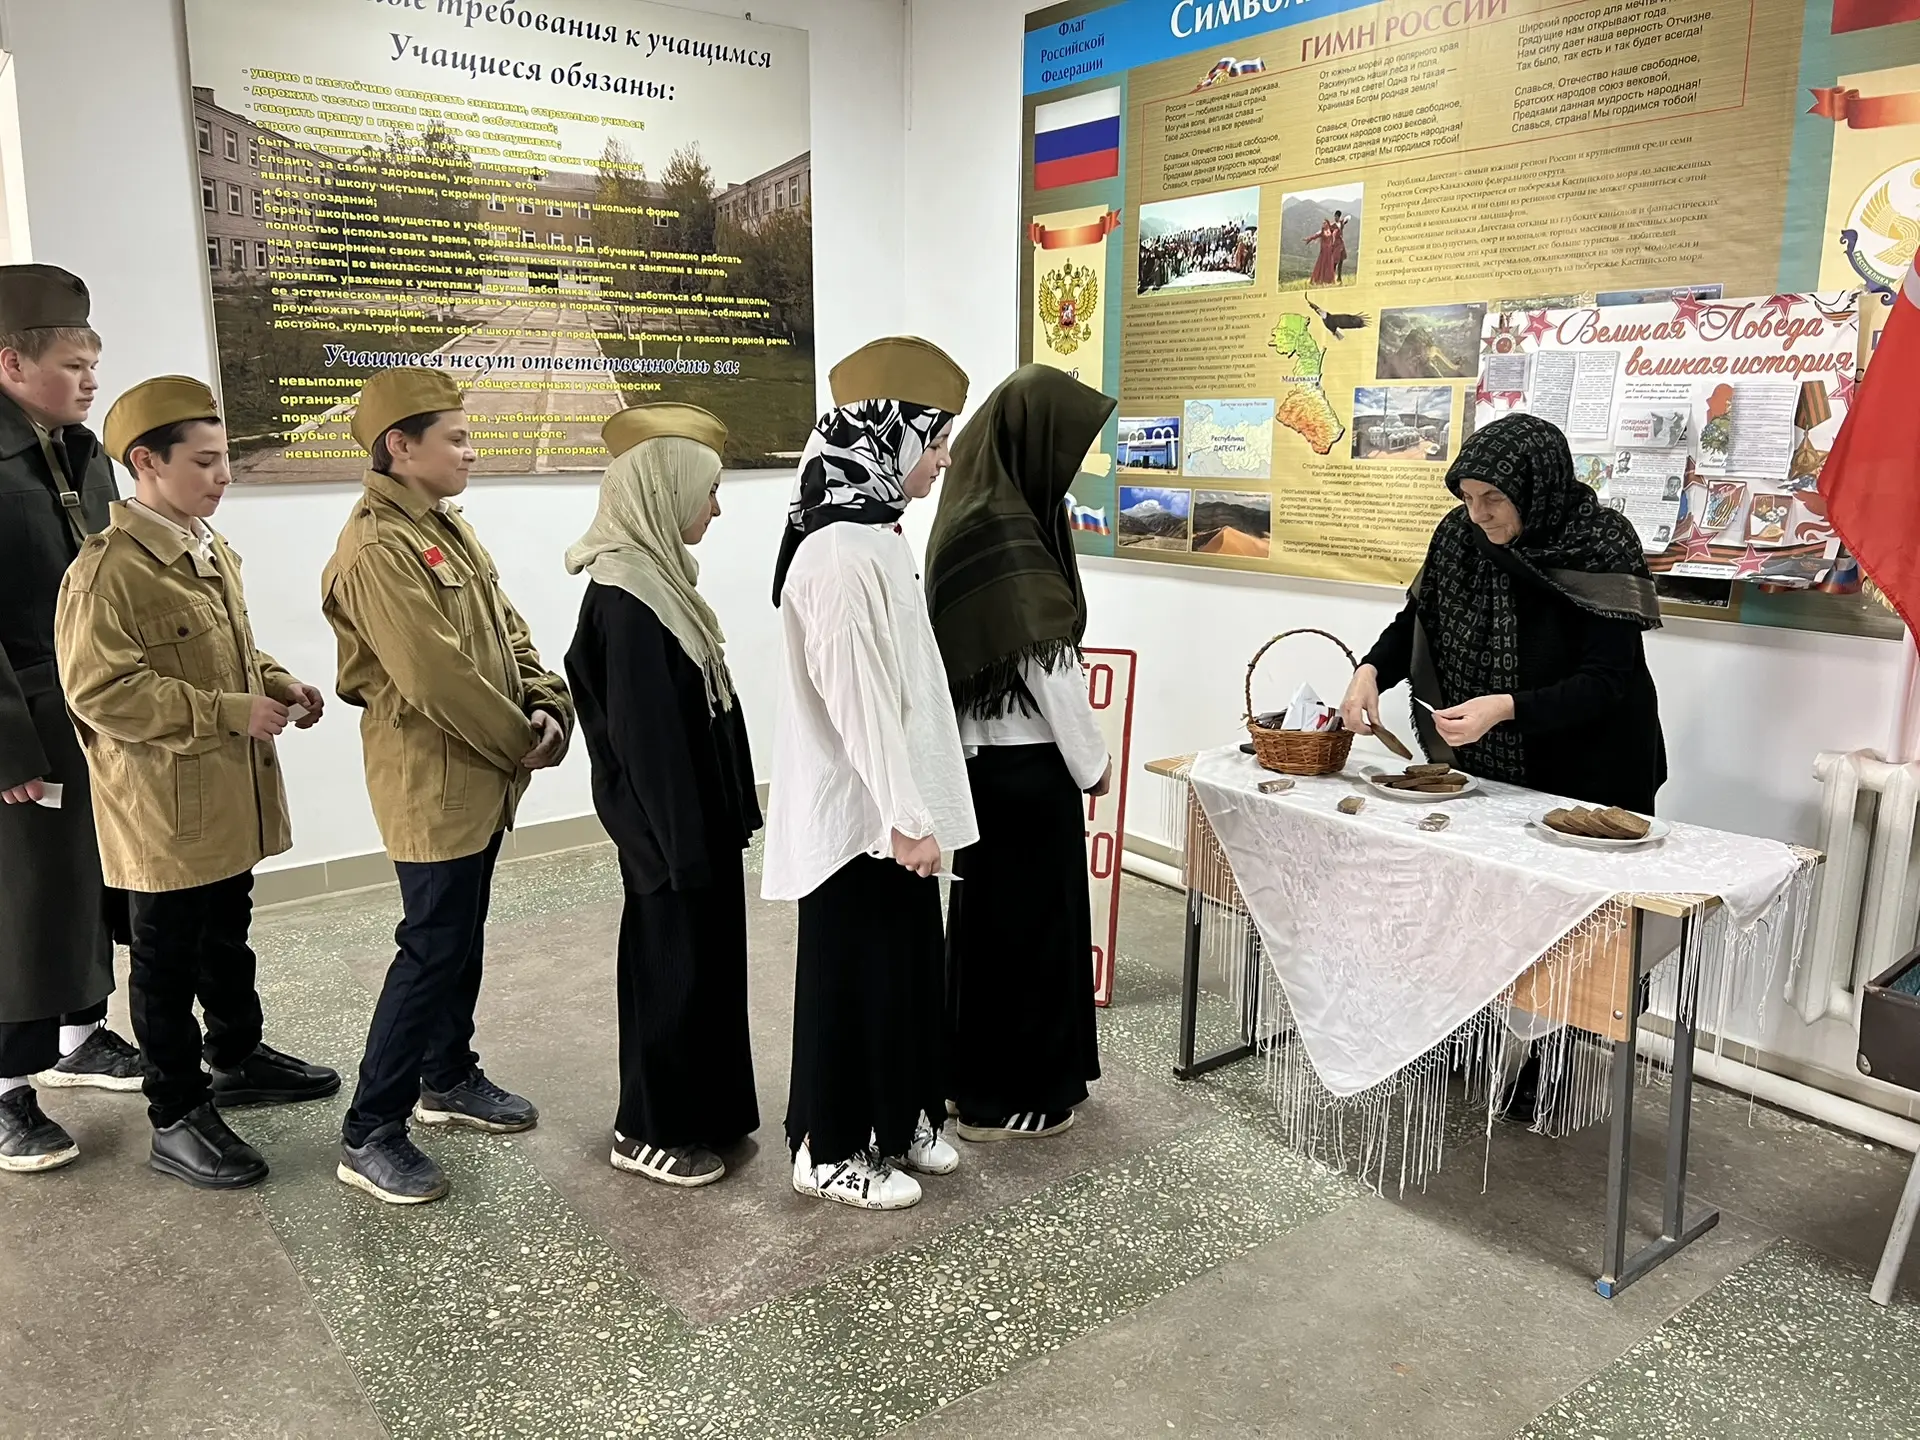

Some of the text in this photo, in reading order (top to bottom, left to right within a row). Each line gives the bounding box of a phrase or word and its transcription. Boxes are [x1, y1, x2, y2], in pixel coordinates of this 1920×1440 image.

[437, 0, 772, 69] требования к учащимся
[1058, 18, 1086, 36] Флаг
[1301, 0, 1507, 62] ГИМН РОССИИ
[1517, 13, 1714, 59] Нам силу дает наша верность Отчизне.
[1518, 16, 1560, 34] Широкий
[1562, 10, 1601, 26] простор
[1603, 6, 1623, 18] для
[1518, 9, 1669, 48] Грядущие нам открывают года.
[389, 32, 675, 101] Учащиеся обязаны:
[1040, 33, 1105, 63] Российской
[1516, 25, 1703, 71] Так было, так есть и так будет всегда!
[1041, 58, 1103, 84] Федерации
[1514, 56, 1700, 97] Славься, Отечество наше свободное,
[250, 68, 645, 132] упорно и настойчиво овладевать знаниями, старательно учиться;
[1512, 78, 1701, 122] Предками данная мудрость народная!
[1514, 72, 1670, 110] Братских народов союз вековой,
[252, 85, 559, 136] дорожить честью школы как своей собственной;
[1511, 92, 1698, 133] Славься, страна! Мы гордимся тобой!
[257, 133, 549, 179] быть не терпимым к равнодушию, лицемерию;
[259, 154, 537, 193] следить за своим здоровьем, укреплять его;
[262, 186, 378, 209] и без опозданий;
[263, 202, 522, 237] беречь школьное имущество и учебники;
[265, 220, 742, 264] полностью использовать время, предназначенное для обучения, прилежно работать
[273, 303, 426, 320] преумножать традиции;
[1556, 308, 1686, 345] Великая
[1699, 303, 1824, 350] Победа
[323, 344, 740, 375] Учащиеся несут ответственность за:
[1624, 346, 1729, 376] великая
[1731, 351, 1853, 381] история
[278, 377, 365, 387] невыполне
[477, 378, 571, 391] общественных
[574, 381, 582, 390] и
[585, 381, 661, 393] ученических
[280, 395, 360, 407] организац
[282, 414, 327, 425] порчу
[494, 411, 560, 425] учебников
[564, 413, 572, 422] и
[575, 413, 610, 422] инвен
[283, 429, 338, 443] грубые
[512, 430, 519, 439] в
[522, 430, 567, 441] школе;
[285, 445, 609, 458] невыполне треннего распорядка.
